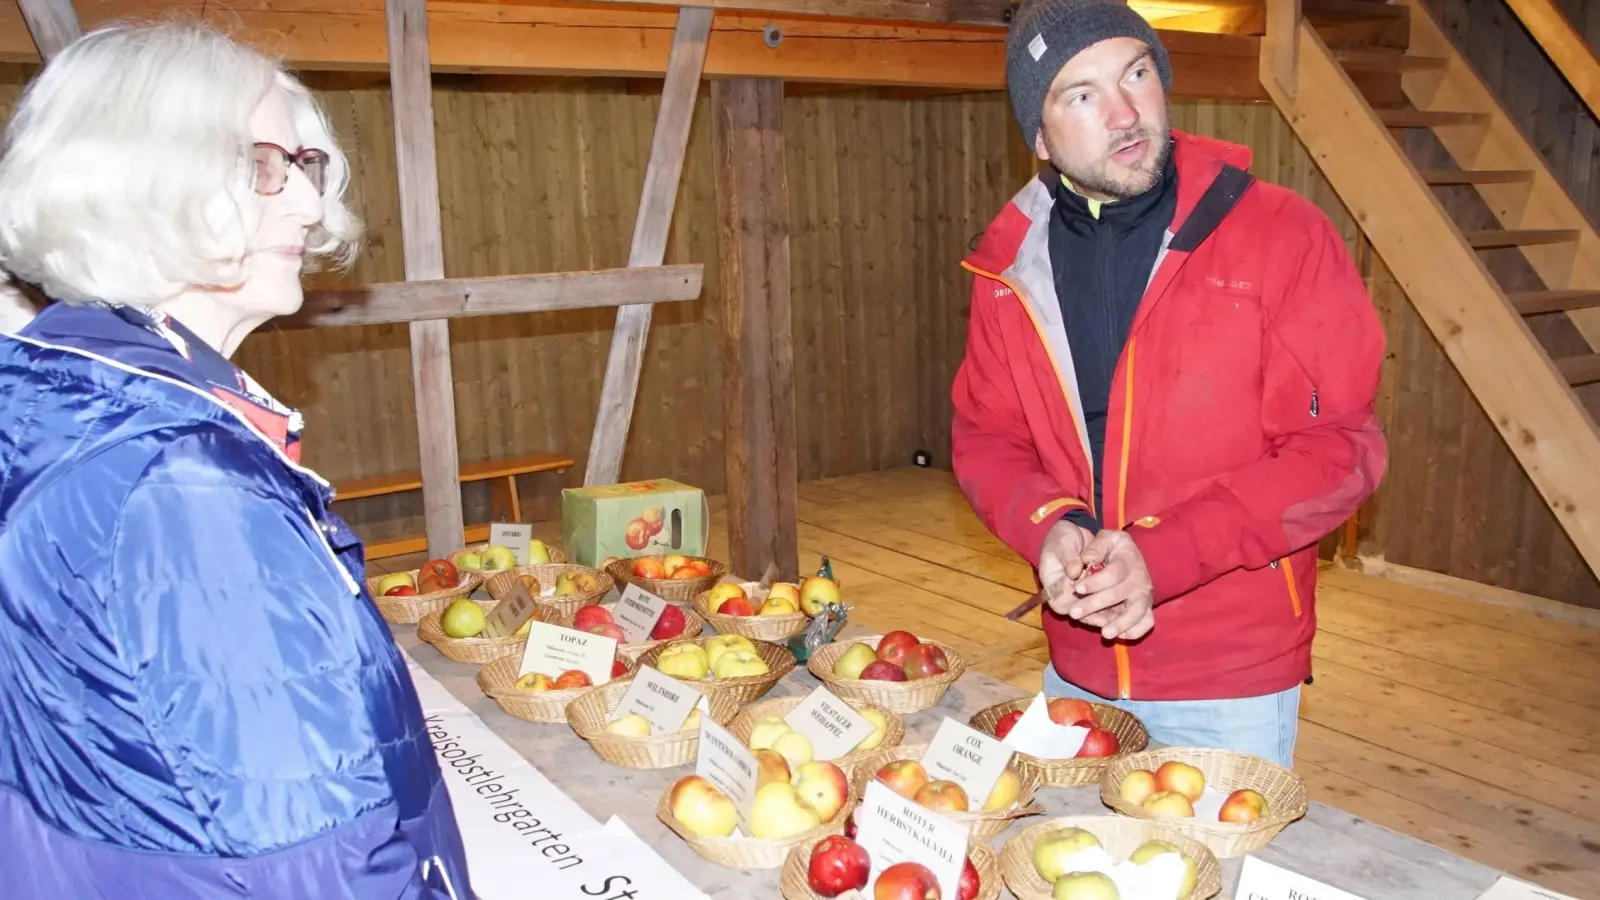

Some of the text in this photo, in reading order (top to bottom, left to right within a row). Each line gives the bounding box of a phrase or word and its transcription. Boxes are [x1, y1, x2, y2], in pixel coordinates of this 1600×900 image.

[560, 633, 588, 646] TOPAZ
[646, 680, 681, 703] WILTSHIRE
[819, 701, 853, 731] VILSTALER
[965, 735, 985, 749] COX
[952, 743, 984, 766] ORANGE
[902, 806, 936, 834] ROTER
[876, 805, 956, 864] HERBSTKALVILL
